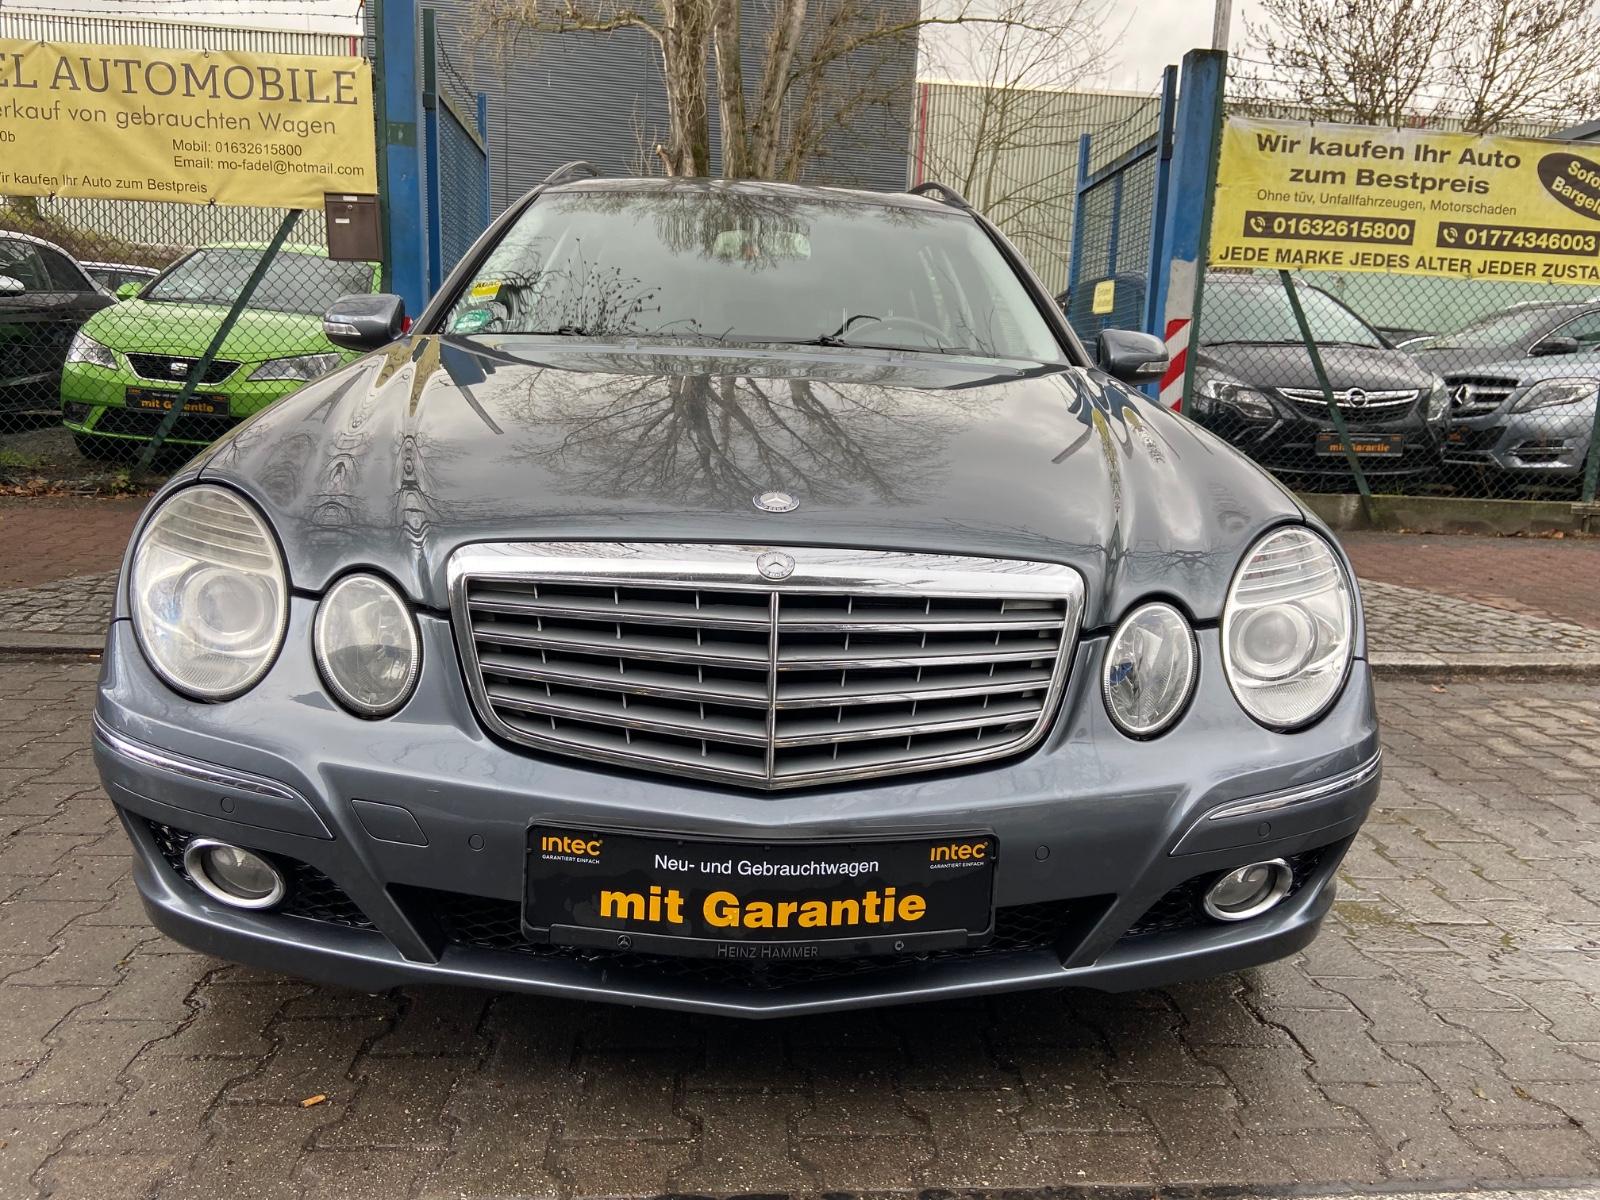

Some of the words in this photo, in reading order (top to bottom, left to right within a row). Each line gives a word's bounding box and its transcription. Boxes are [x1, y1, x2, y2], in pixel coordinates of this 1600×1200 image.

[50, 56, 358, 104] AUTOMOBILE
[0, 98, 60, 121] rkauf
[68, 108, 106, 122] von
[116, 105, 251, 131] gebrauchten
[258, 112, 336, 137] Wagen
[172, 139, 211, 153] Mobil:
[215, 141, 302, 156] 01632615800
[1256, 133, 1301, 153] Wir
[1308, 136, 1405, 160] kaufen
[1414, 143, 1451, 164] Ihr
[1458, 148, 1521, 169] Auto
[174, 156, 214, 169] Email:
[217, 160, 365, 176] mo-fadel@hotmail.com
[1568, 161, 1600, 190] Sofo
[14, 173, 58, 186] kaufen
[63, 174, 77, 186] Ihr
[82, 175, 112, 188] Auto
[116, 179, 143, 190] zum
[147, 178, 208, 194] Bestpreis
[1289, 167, 1346, 185] zum
[1356, 168, 1490, 195] Bestpreis
[1257, 189, 1291, 202] Ohne
[1295, 190, 1316, 206] tüv,
[1319, 192, 1426, 212] Unfallfahrzeugen,
[1430, 200, 1517, 216] Motorschaden
[1273, 216, 1410, 241] 01632615800
[1464, 228, 1596, 252] 01774346003
[1219, 246, 1269, 262] JEDE
[1275, 248, 1343, 265] MARKE
[1350, 251, 1410, 269] JEDES
[1415, 254, 1472, 273] ALTER
[1477, 259, 1536, 276] JEDER
[1542, 262, 1600, 280] ZUSTA
[542, 836, 600, 856] intec
[930, 843, 986, 861] intec
[654, 854, 695, 870] Neu-
[700, 858, 732, 875] und
[737, 857, 879, 877] Gebrauchtwagen
[600, 886, 684, 925] mit
[703, 887, 927, 928] Garantie
